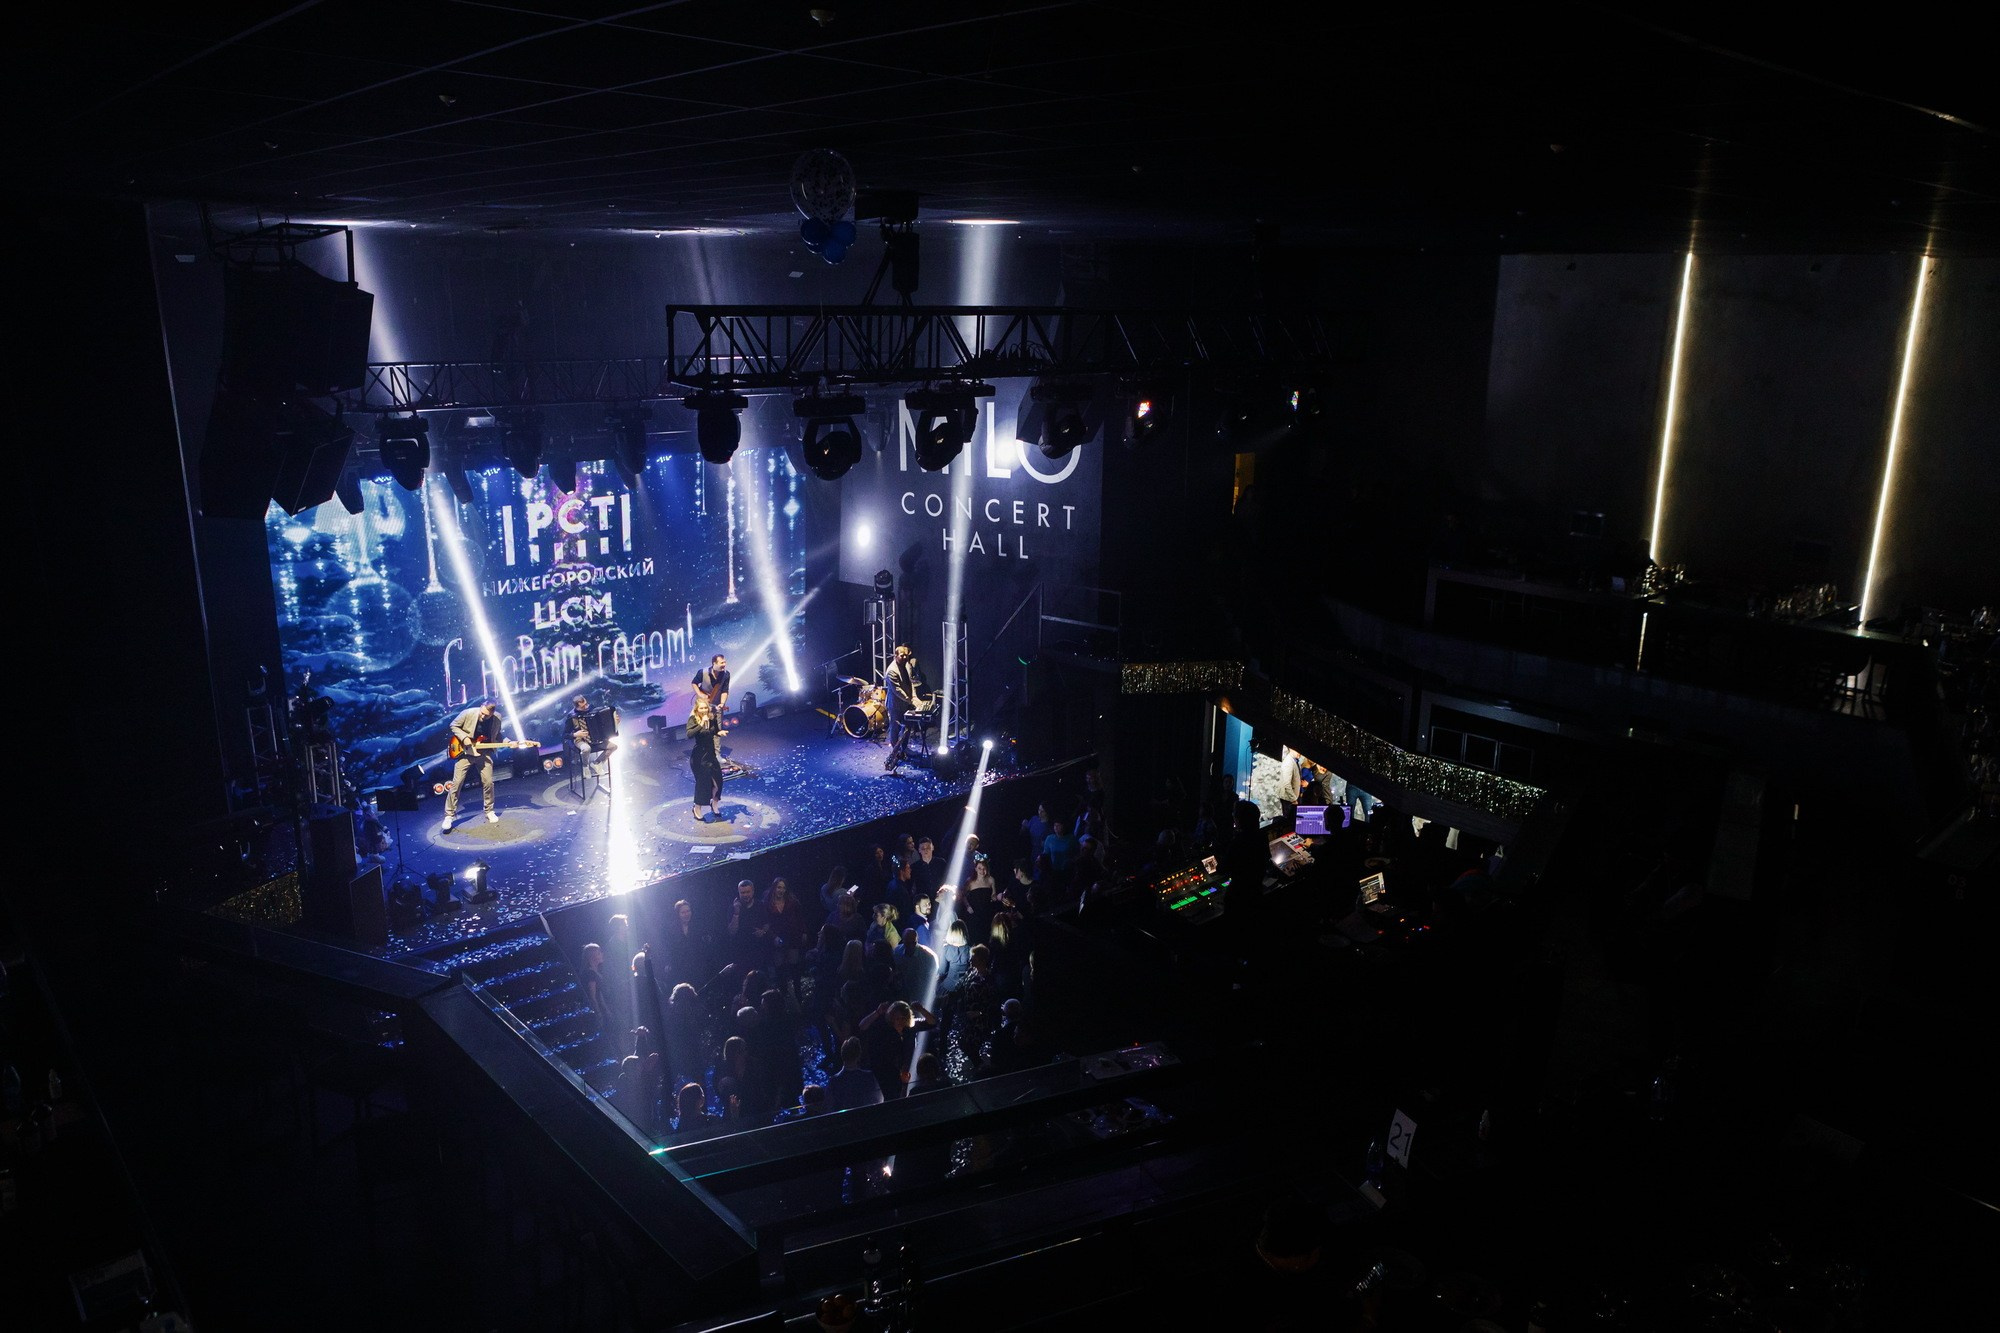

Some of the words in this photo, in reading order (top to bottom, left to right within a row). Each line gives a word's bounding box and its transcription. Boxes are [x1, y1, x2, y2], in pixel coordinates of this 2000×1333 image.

[901, 491, 1075, 530] CONCERT
[942, 528, 1029, 560] HALL
[482, 557, 655, 597] НИЖЕГОРОДСКИЙ
[533, 592, 613, 630] ЦСМ
[1389, 1121, 1412, 1157] 21
